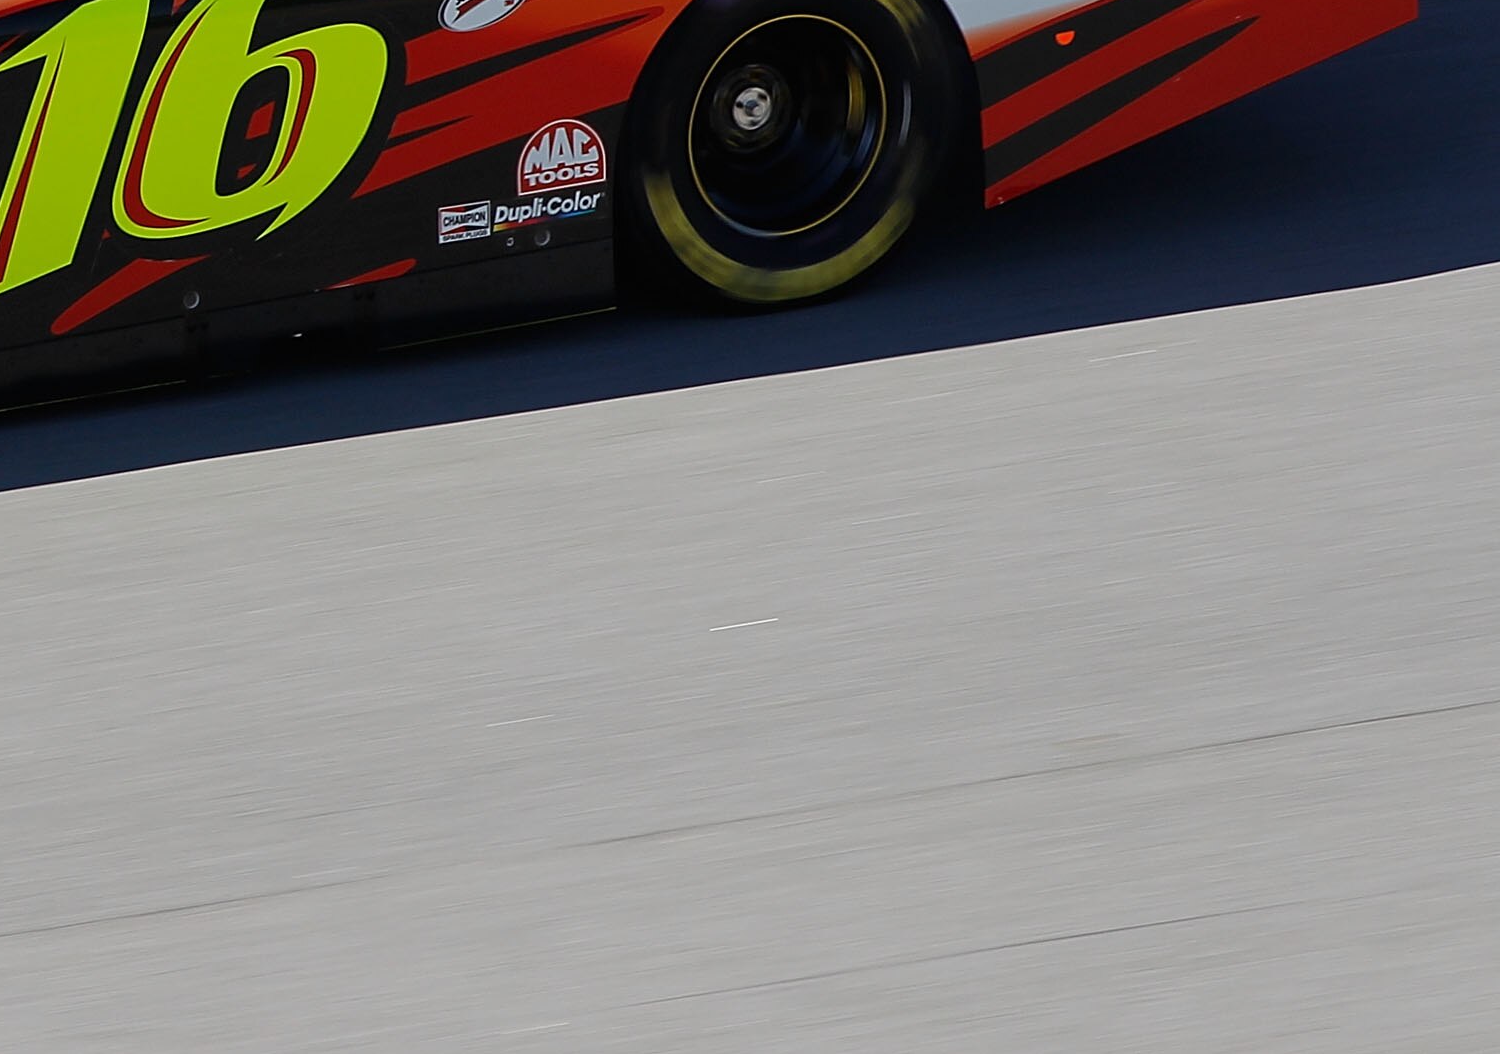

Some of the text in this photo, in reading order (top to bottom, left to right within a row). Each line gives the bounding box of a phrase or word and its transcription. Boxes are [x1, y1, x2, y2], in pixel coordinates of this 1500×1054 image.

[524, 126, 600, 173] MAC
[524, 163, 600, 186] TOOLS
[442, 209, 488, 227] CHAMPION
[442, 229, 489, 242] SPARK PLUGS
